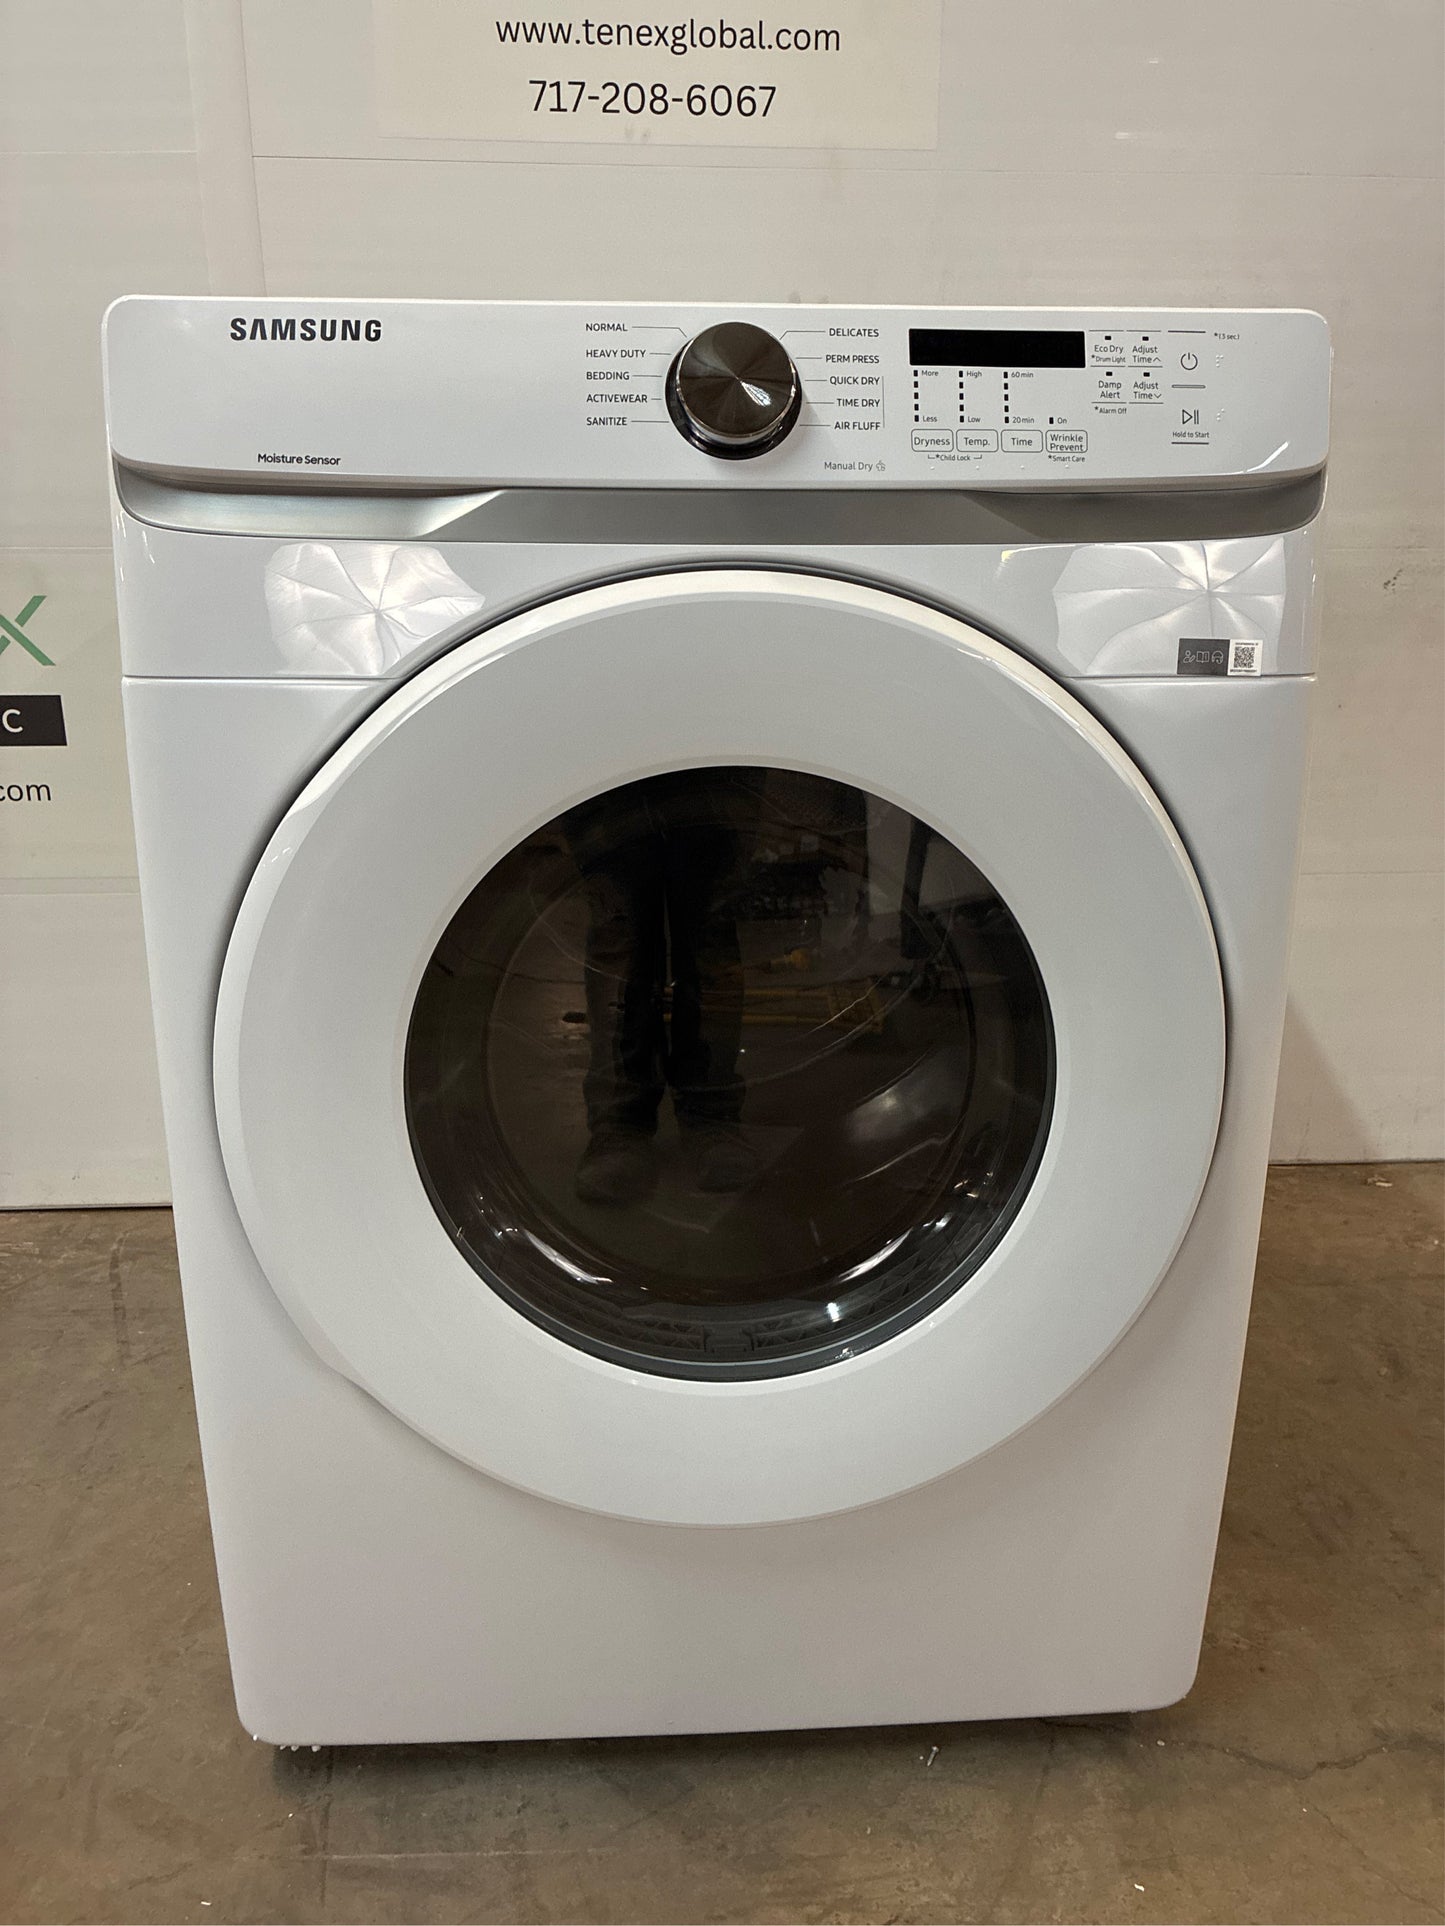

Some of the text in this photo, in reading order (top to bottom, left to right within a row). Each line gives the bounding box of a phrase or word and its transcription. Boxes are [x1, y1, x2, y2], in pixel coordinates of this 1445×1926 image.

[496, 18, 841, 55] www.tenexglobal.com
[529, 79, 776, 117] 717-208-6067
[230, 318, 382, 342] SAMSUNG
[585, 323, 628, 332] NORMAL
[829, 328, 879, 338] DELICATES
[586, 349, 646, 358] HEAVY DUTY
[1109, 345, 1124, 354] Dry
[1132, 345, 1158, 354] Adjust
[825, 355, 880, 363] PERM PRESS
[1133, 355, 1152, 363] Time
[586, 372, 630, 381] BEDDING
[966, 370, 982, 378] High
[829, 376, 880, 386] QUICK DRY
[1098, 381, 1122, 391] Damp
[1133, 381, 1159, 391] Adjust
[586, 394, 648, 403] ACTIVEWEAR
[1100, 391, 1120, 399] Alert
[1134, 391, 1153, 400] Time
[837, 399, 880, 408] TIME DRY
[1118, 407, 1127, 415] Off
[586, 417, 628, 426] SANITIZE
[834, 421, 881, 430] AIR FLUFF
[914, 437, 950, 446] Dryness
[964, 437, 990, 447] Temp.
[1011, 438, 1033, 446] Time
[1050, 434, 1083, 442] Wrinkle
[1050, 443, 1084, 451] Prevent
[257, 453, 341, 466] Moisture Sensor
[824, 462, 873, 473] Manual Dry
